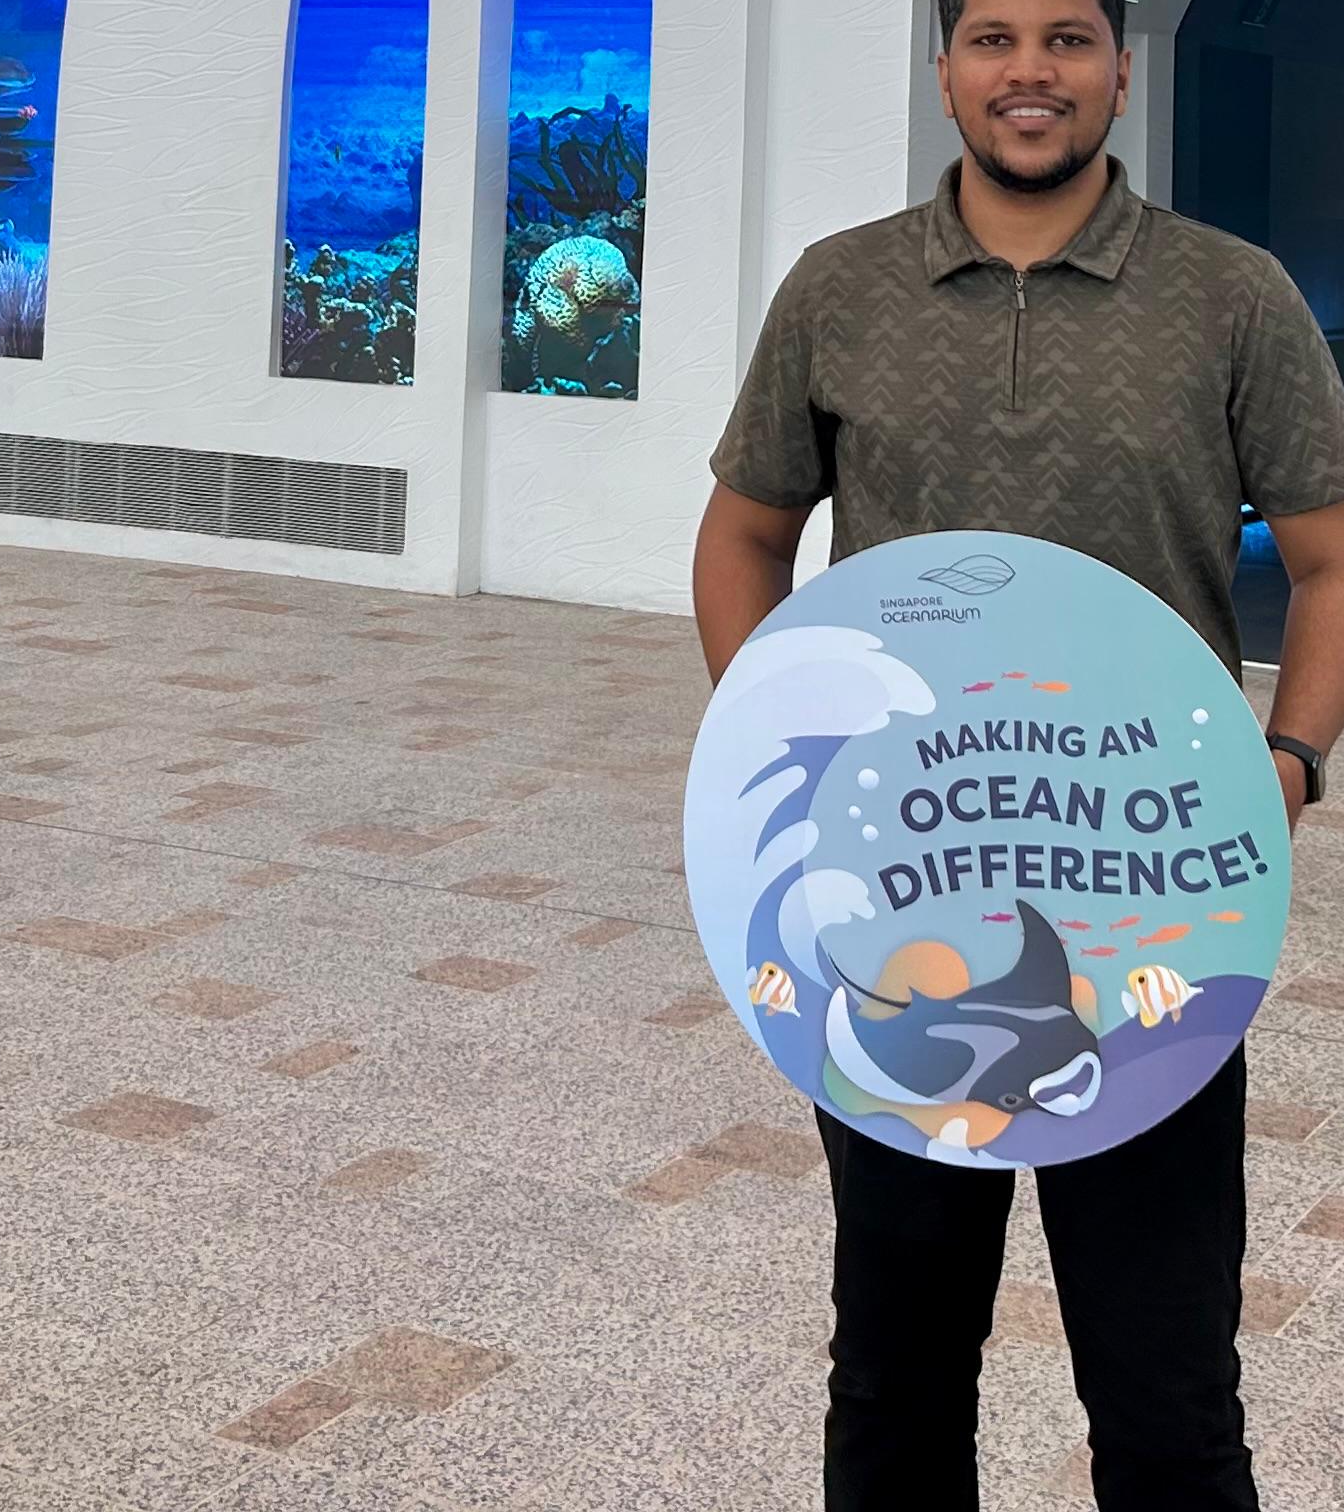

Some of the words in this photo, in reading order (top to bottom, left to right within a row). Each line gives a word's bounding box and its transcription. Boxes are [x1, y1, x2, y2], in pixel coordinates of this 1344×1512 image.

[879, 596, 943, 609] SINGAPORE
[881, 608, 981, 624] OCEANARIUM
[915, 719, 1087, 770] MAKING
[1098, 717, 1158, 758] AN
[900, 775, 1106, 833] OCEAN
[1124, 779, 1202, 834] OF
[878, 831, 1268, 911] DIFFERENCE!
